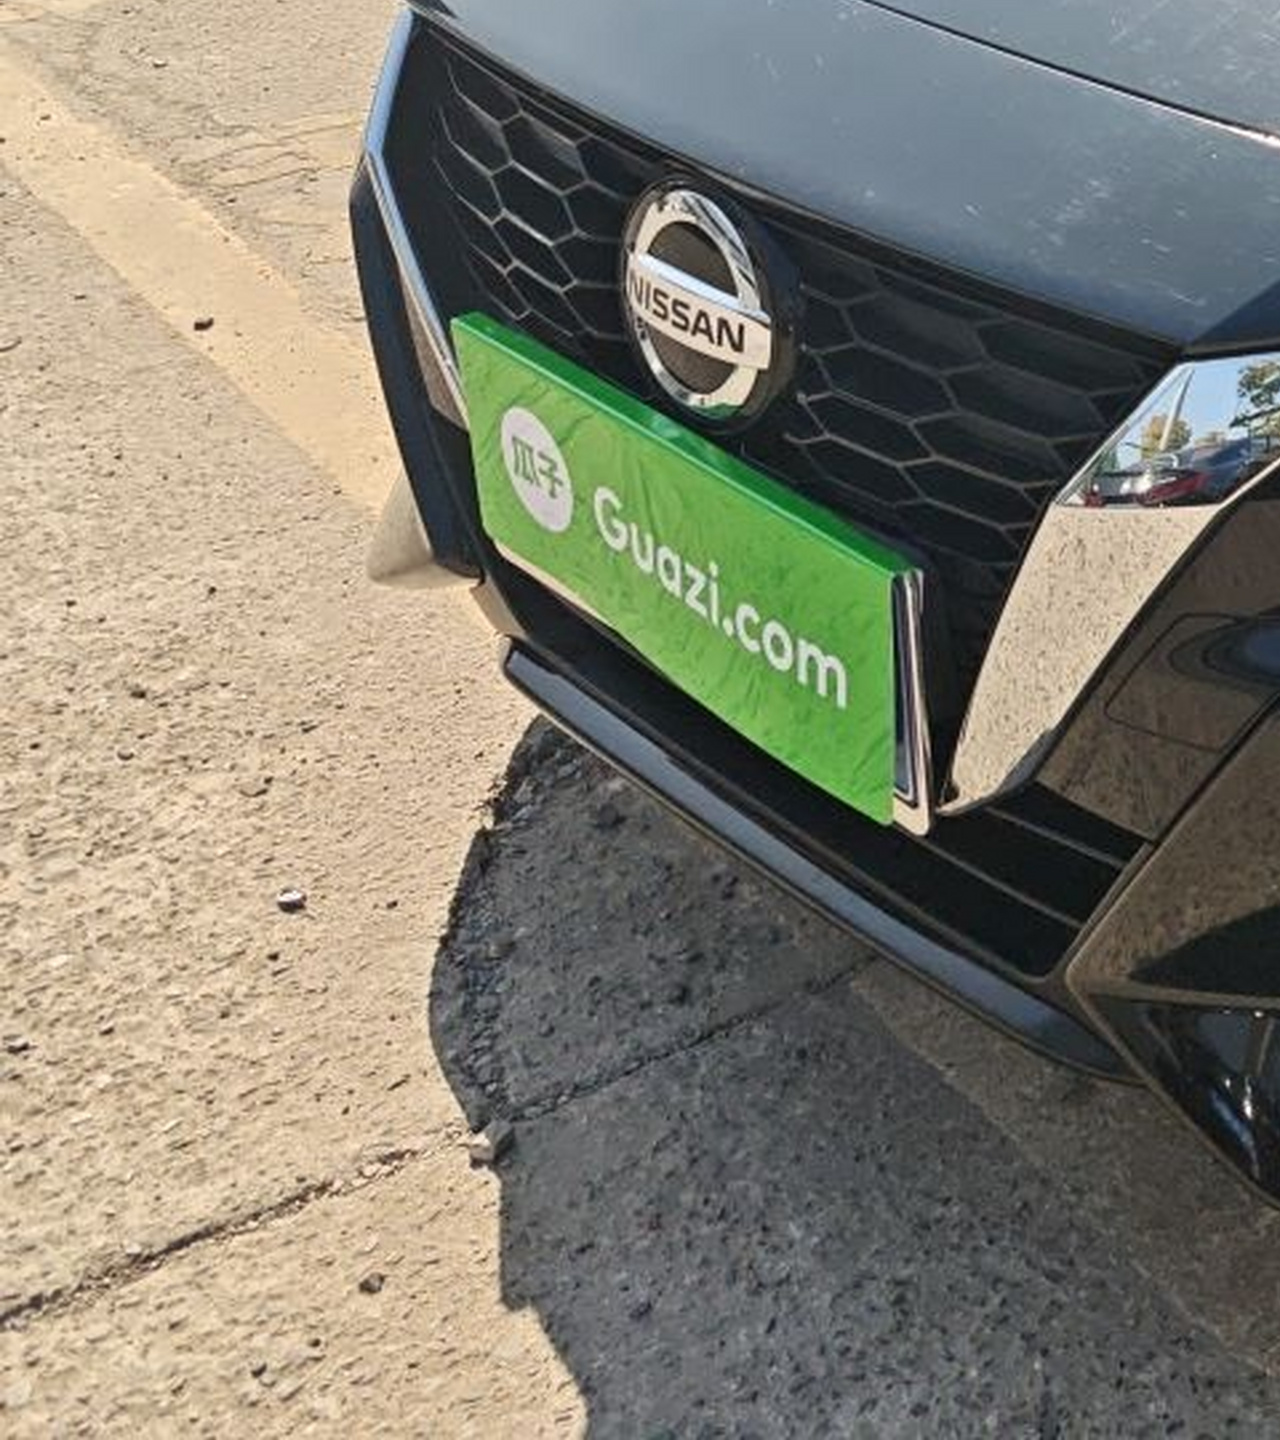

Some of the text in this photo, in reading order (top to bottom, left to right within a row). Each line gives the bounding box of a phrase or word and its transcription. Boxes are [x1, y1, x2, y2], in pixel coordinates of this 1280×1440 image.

[629, 268, 745, 354] NISSAN
[511, 436, 564, 499] 瓜子
[594, 486, 847, 709] Guazi.com
